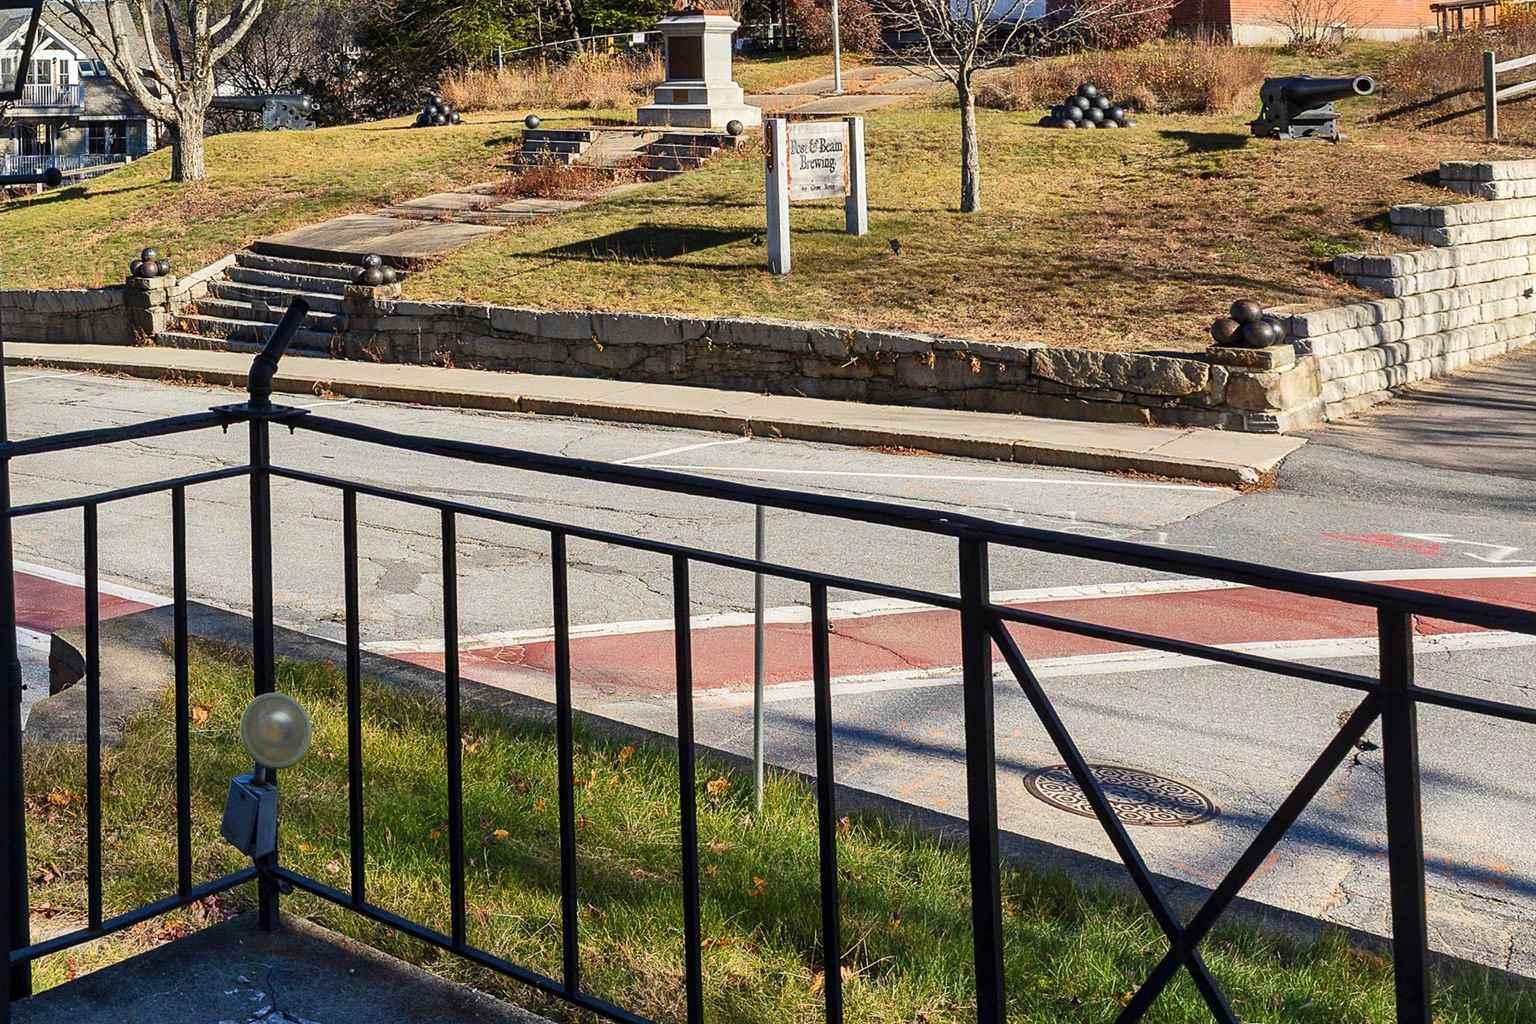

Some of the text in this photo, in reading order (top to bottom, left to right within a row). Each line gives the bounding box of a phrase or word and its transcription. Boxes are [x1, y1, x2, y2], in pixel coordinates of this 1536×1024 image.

[809, 137, 819, 154] &
[819, 137, 843, 154] Beam
[800, 155, 836, 173] Brewing
